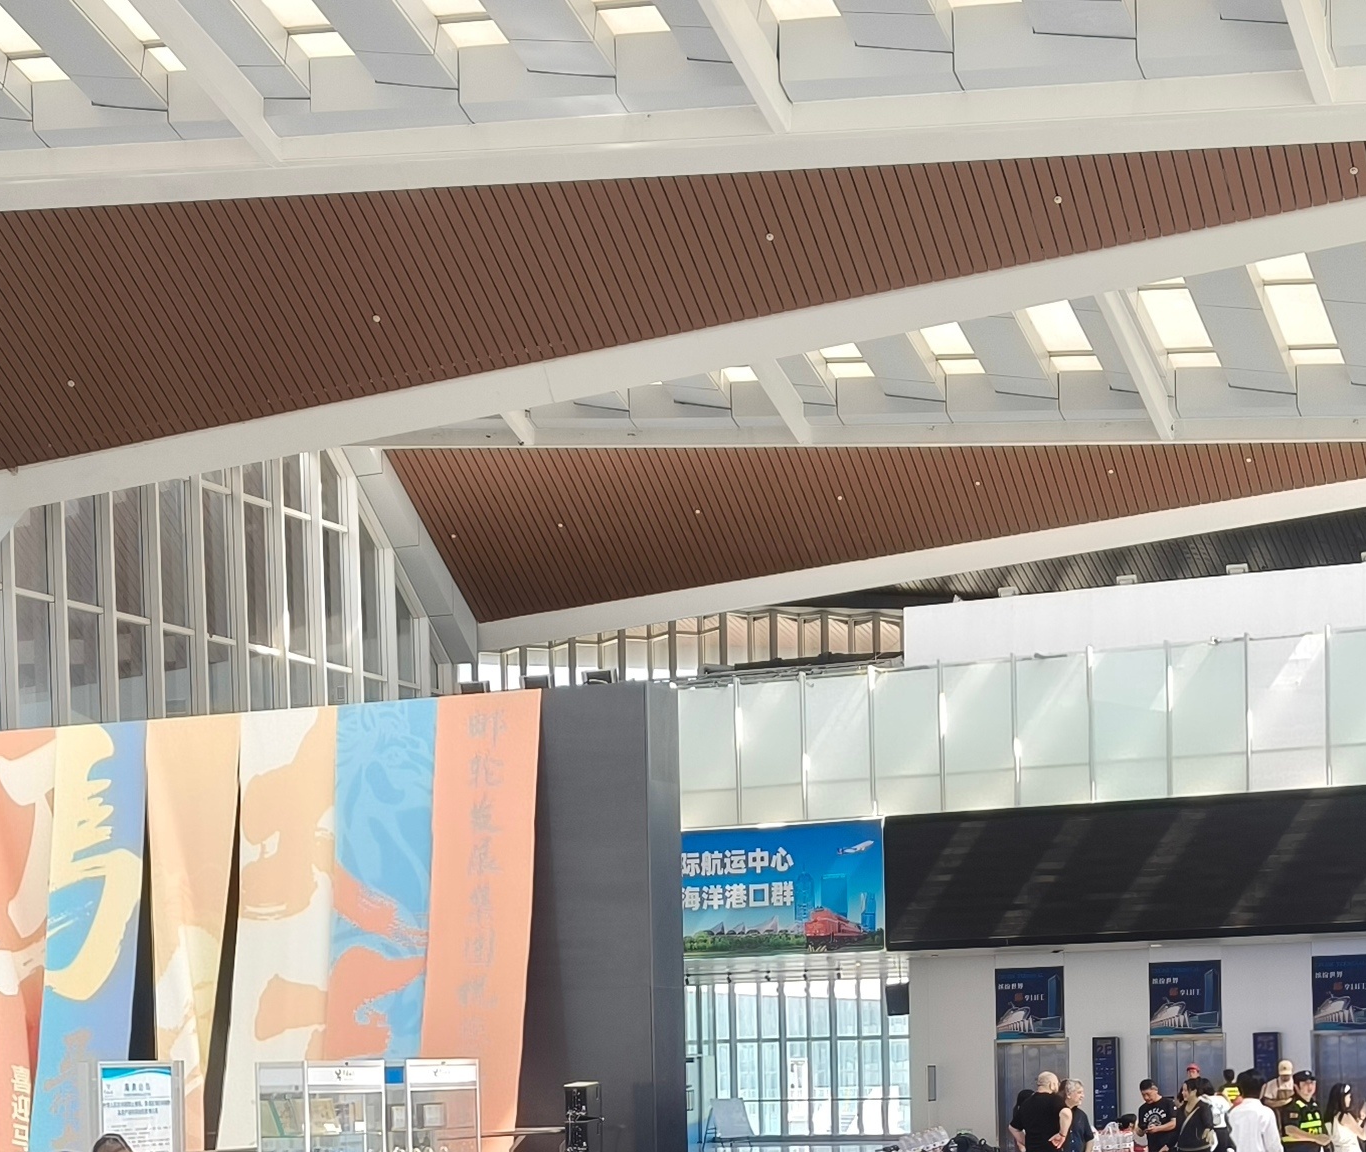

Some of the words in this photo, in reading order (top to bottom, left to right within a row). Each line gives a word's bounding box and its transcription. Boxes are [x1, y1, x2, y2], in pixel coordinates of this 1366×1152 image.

[682, 881, 795, 911] 海洋港口群
